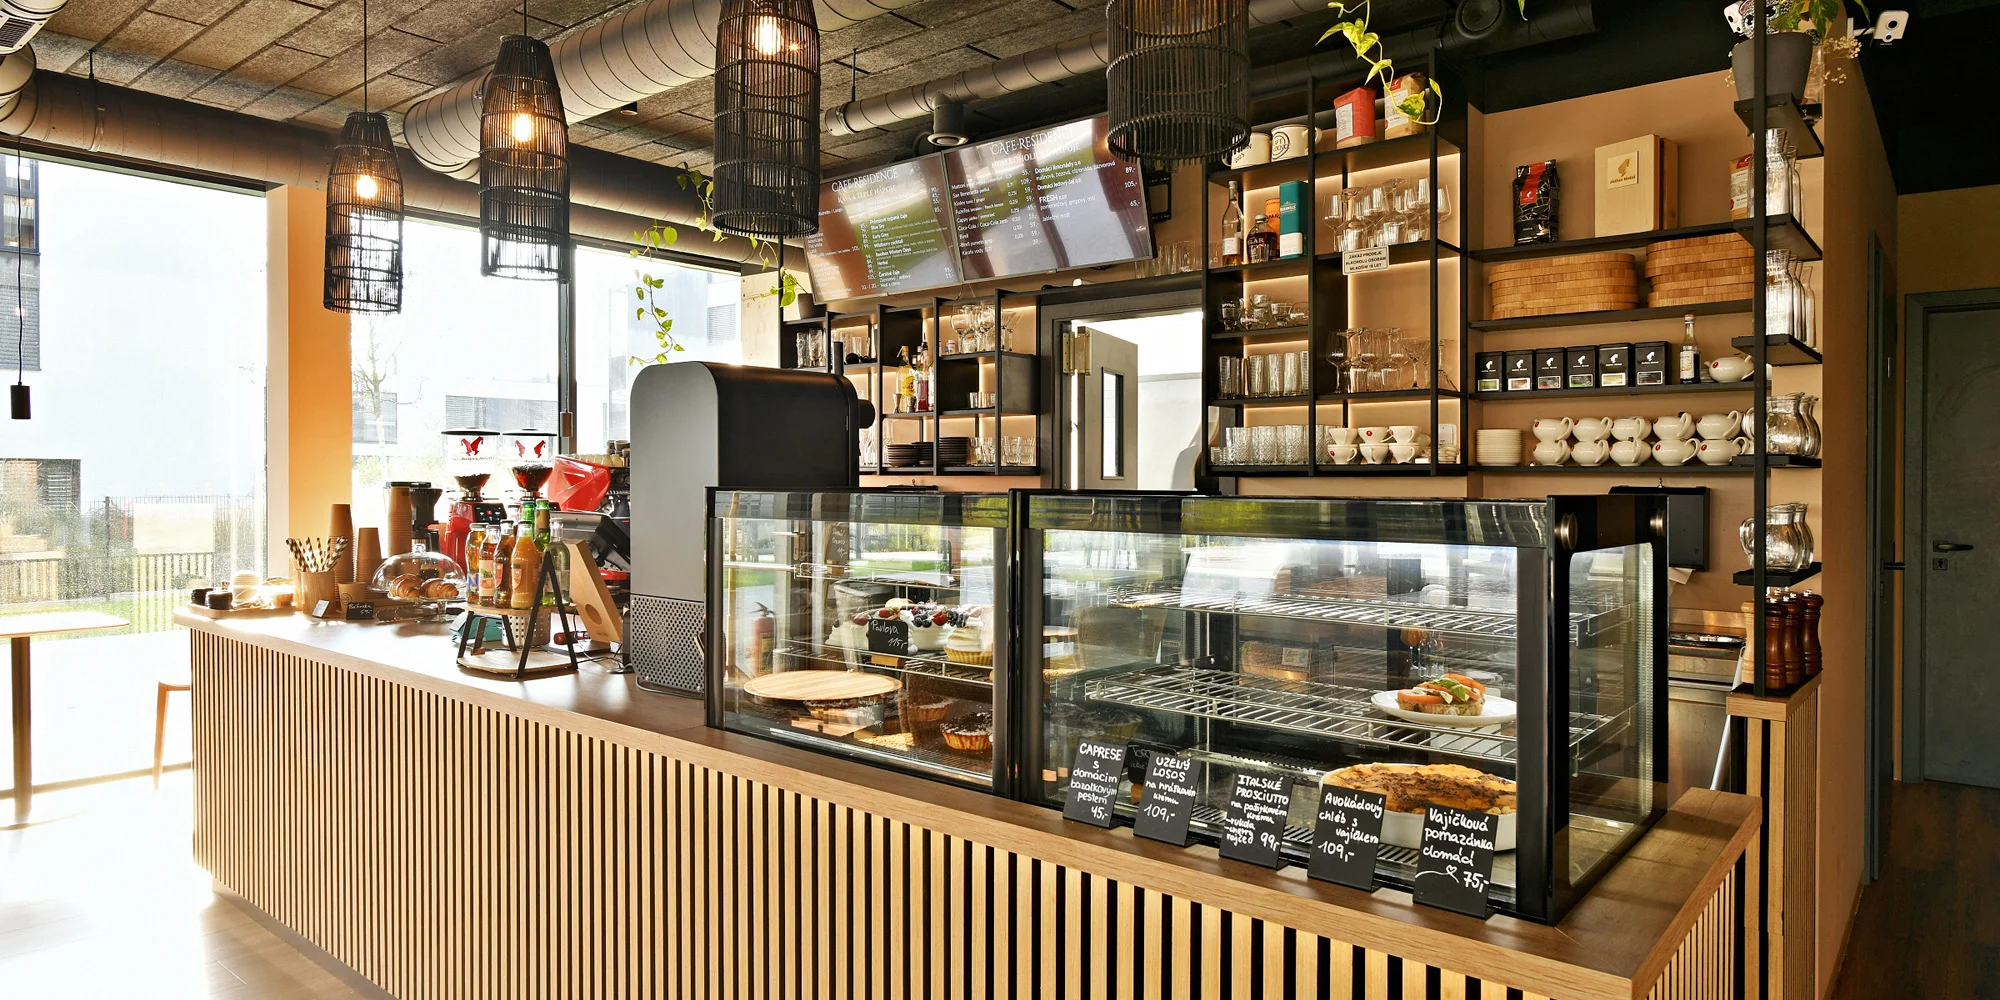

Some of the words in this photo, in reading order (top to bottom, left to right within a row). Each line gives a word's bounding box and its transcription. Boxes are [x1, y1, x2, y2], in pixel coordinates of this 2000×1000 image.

[1039, 194, 1058, 203] FRESH
[871, 620, 899, 635] Pavlova
[1079, 742, 1122, 761] CAPRESE
[1156, 756, 1190, 771] UZENÝ
[1153, 767, 1186, 782] LOSOS
[1237, 774, 1283, 790] ITALSKÉ
[1146, 780, 1156, 789] na
[1077, 792, 1107, 804] pestem
[1325, 792, 1383, 819] Avokádový
[1091, 805, 1108, 820] 45,-
[1144, 804, 1175, 822] 109,-
[1319, 810, 1346, 824] chléb
[1352, 818, 1358, 827] s
[1430, 807, 1489, 831] Vajíčková
[1425, 828, 1494, 850] pomazánka
[1318, 841, 1355, 862] 109,-
[1423, 845, 1474, 867] domácí
[1463, 871, 1489, 893] 75,-
